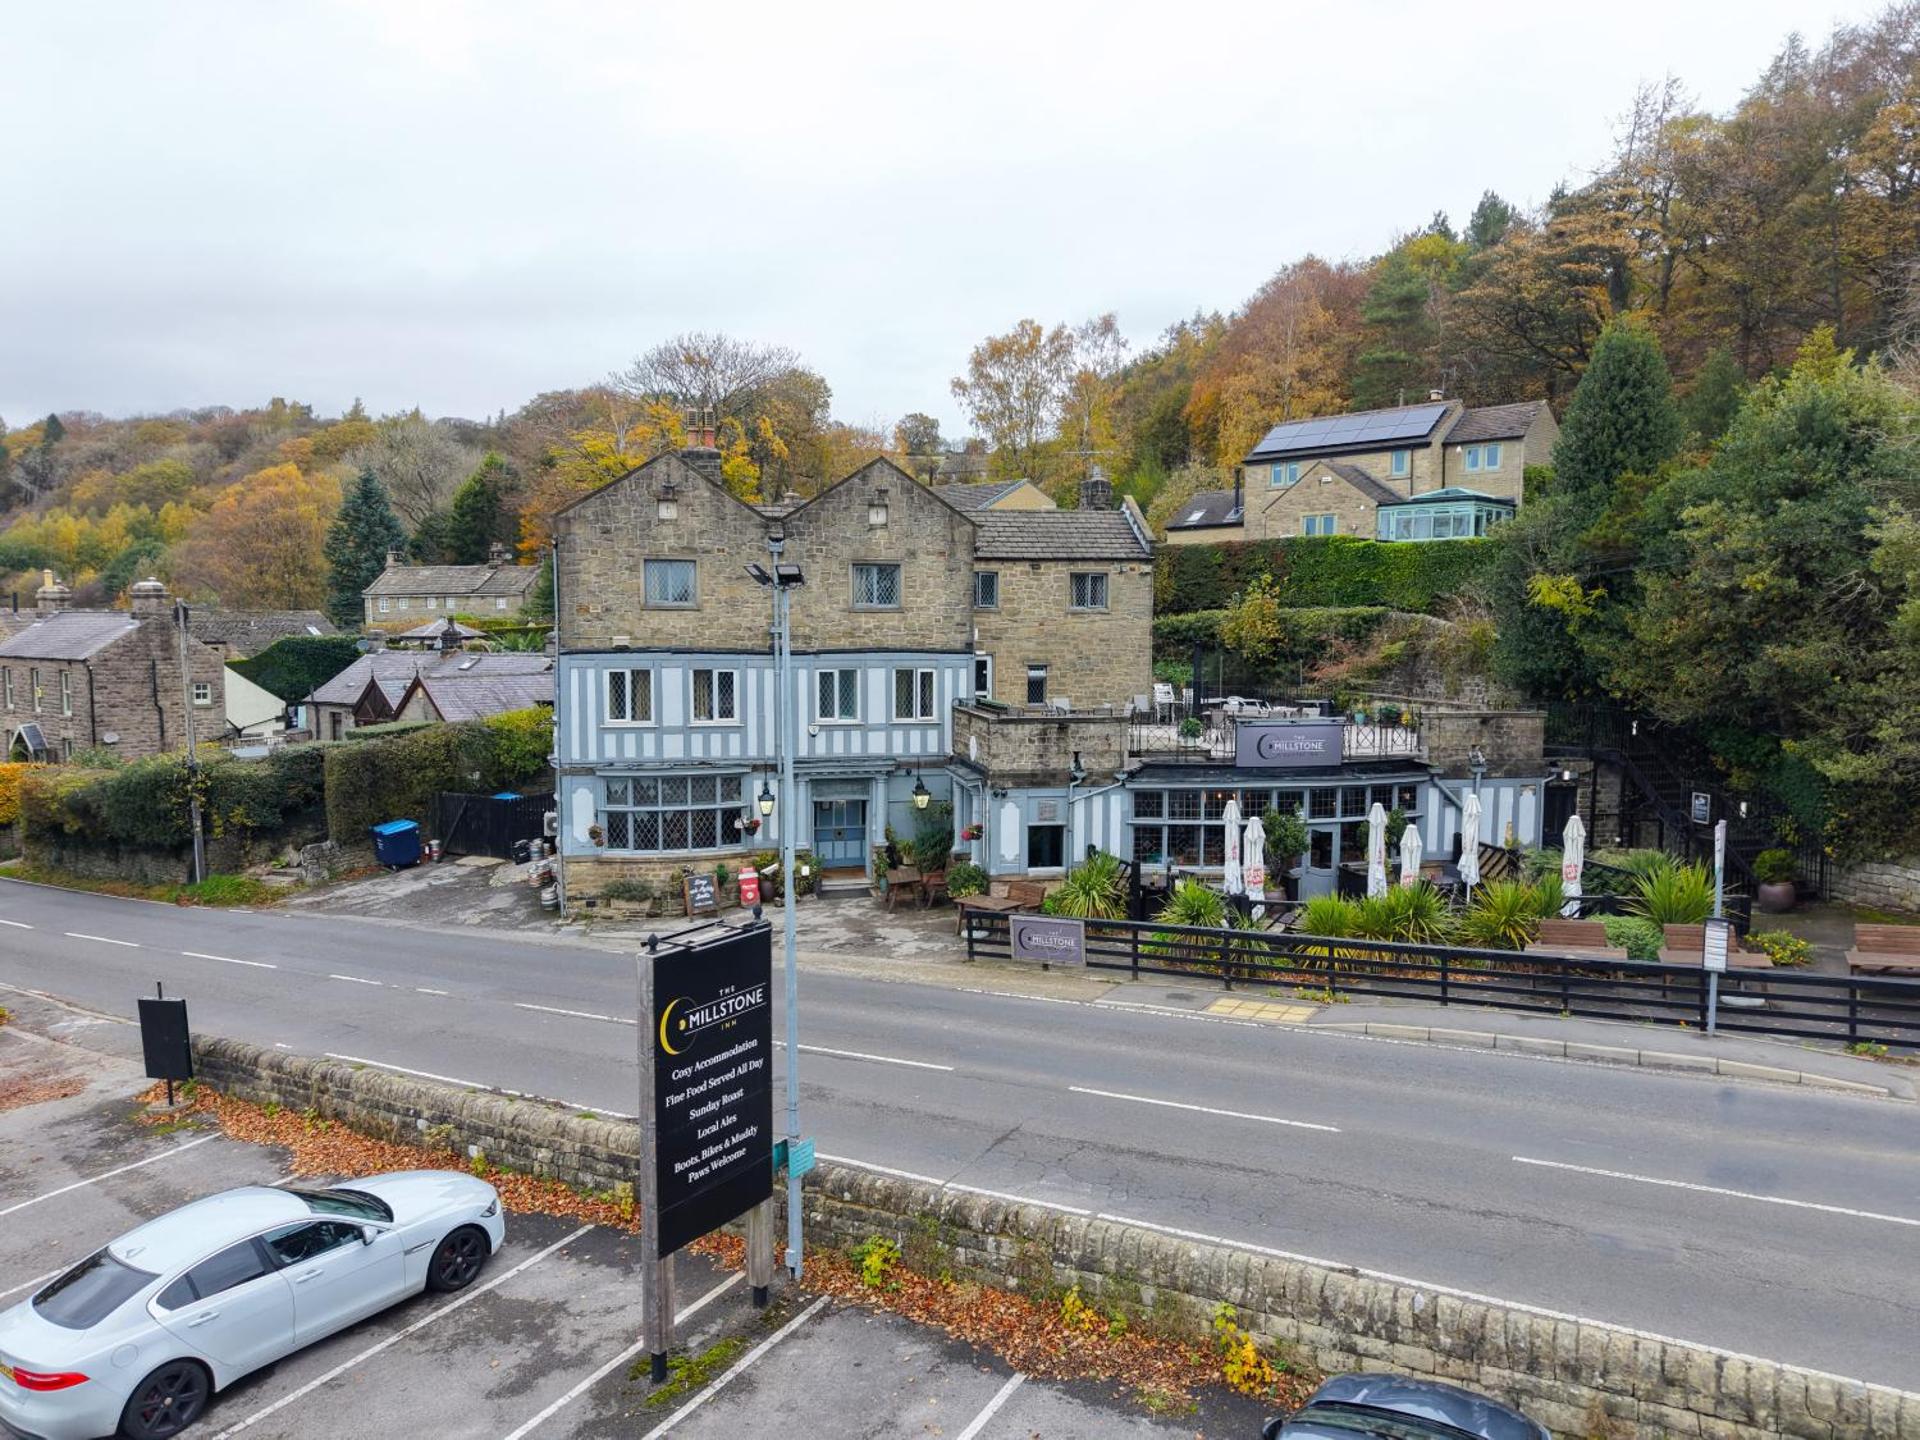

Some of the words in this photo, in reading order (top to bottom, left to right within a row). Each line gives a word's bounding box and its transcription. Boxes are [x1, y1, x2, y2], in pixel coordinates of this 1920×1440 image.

[1274, 741, 1324, 751] MILLSTONE
[719, 985, 735, 996] THE
[689, 988, 763, 1028] MILLSTONE
[721, 1019, 737, 1031] INN
[671, 1065, 694, 1080] Cosy
[694, 1038, 758, 1072] Accommodation
[665, 1092, 686, 1108] Fine
[686, 1080, 708, 1099] Food
[708, 1068, 736, 1089] Served
[737, 1062, 748, 1076] All
[749, 1057, 764, 1070] Day
[689, 1100, 720, 1120] Sunday
[722, 1088, 744, 1106] Roast
[697, 1120, 719, 1139] Local
[720, 1114, 738, 1128] Ales
[701, 1143, 723, 1160] Bikes
[724, 1138, 731, 1149] &
[731, 1125, 759, 1145] Muddy
[688, 1166, 710, 1183] Paws
[710, 1147, 747, 1171] Welcome
